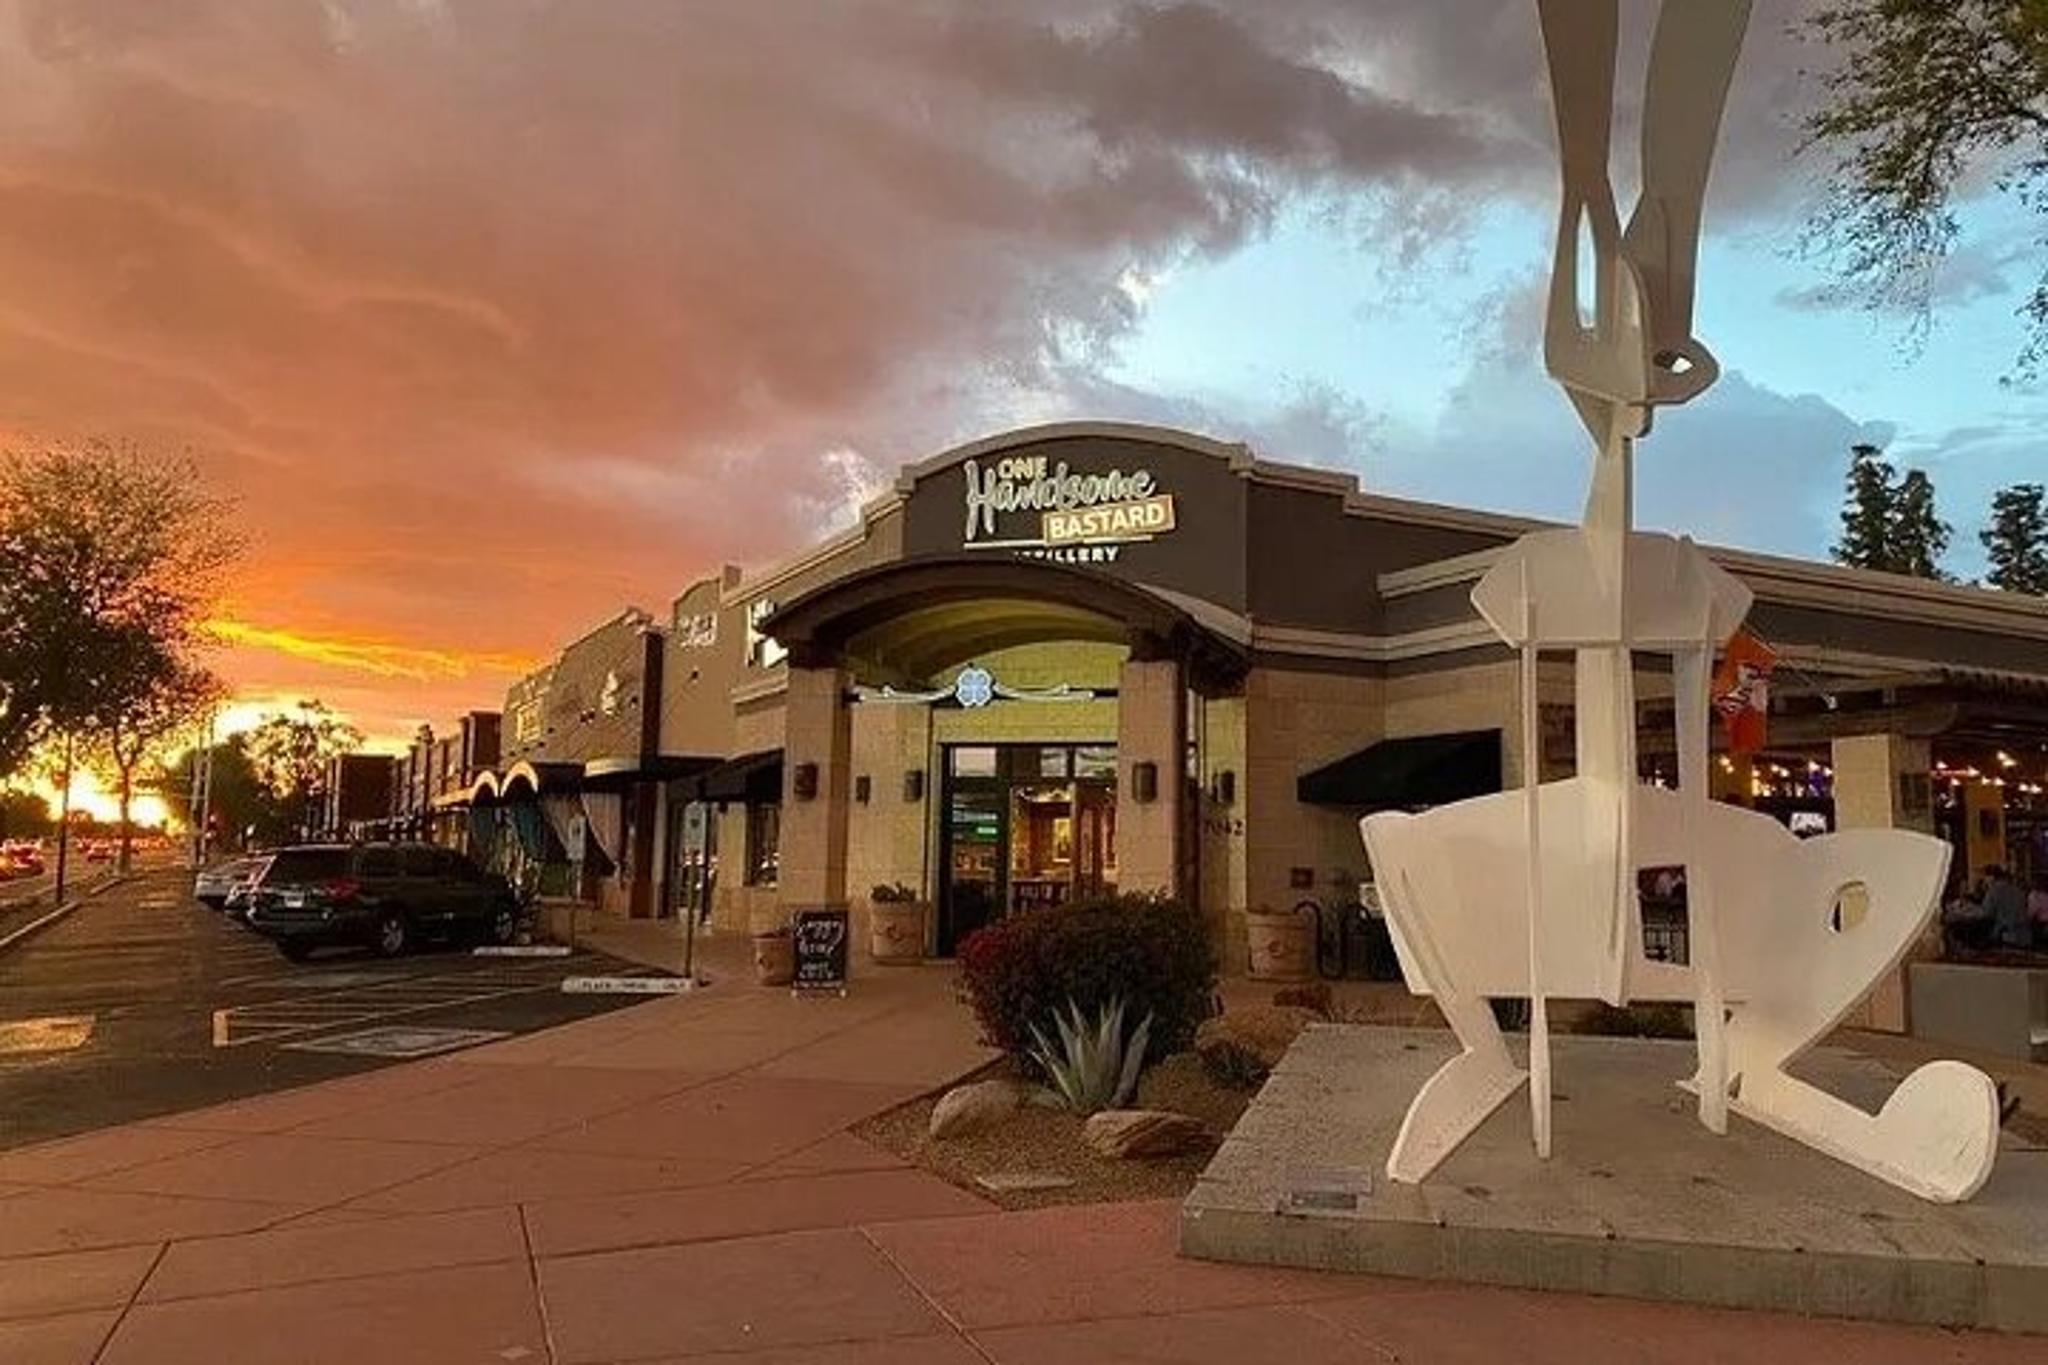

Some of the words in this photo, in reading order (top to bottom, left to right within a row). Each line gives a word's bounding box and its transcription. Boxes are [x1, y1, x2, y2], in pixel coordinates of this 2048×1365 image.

[998, 457, 1048, 479] ONE
[964, 459, 1156, 541] Handsome
[1050, 502, 1165, 539] BASTARD
